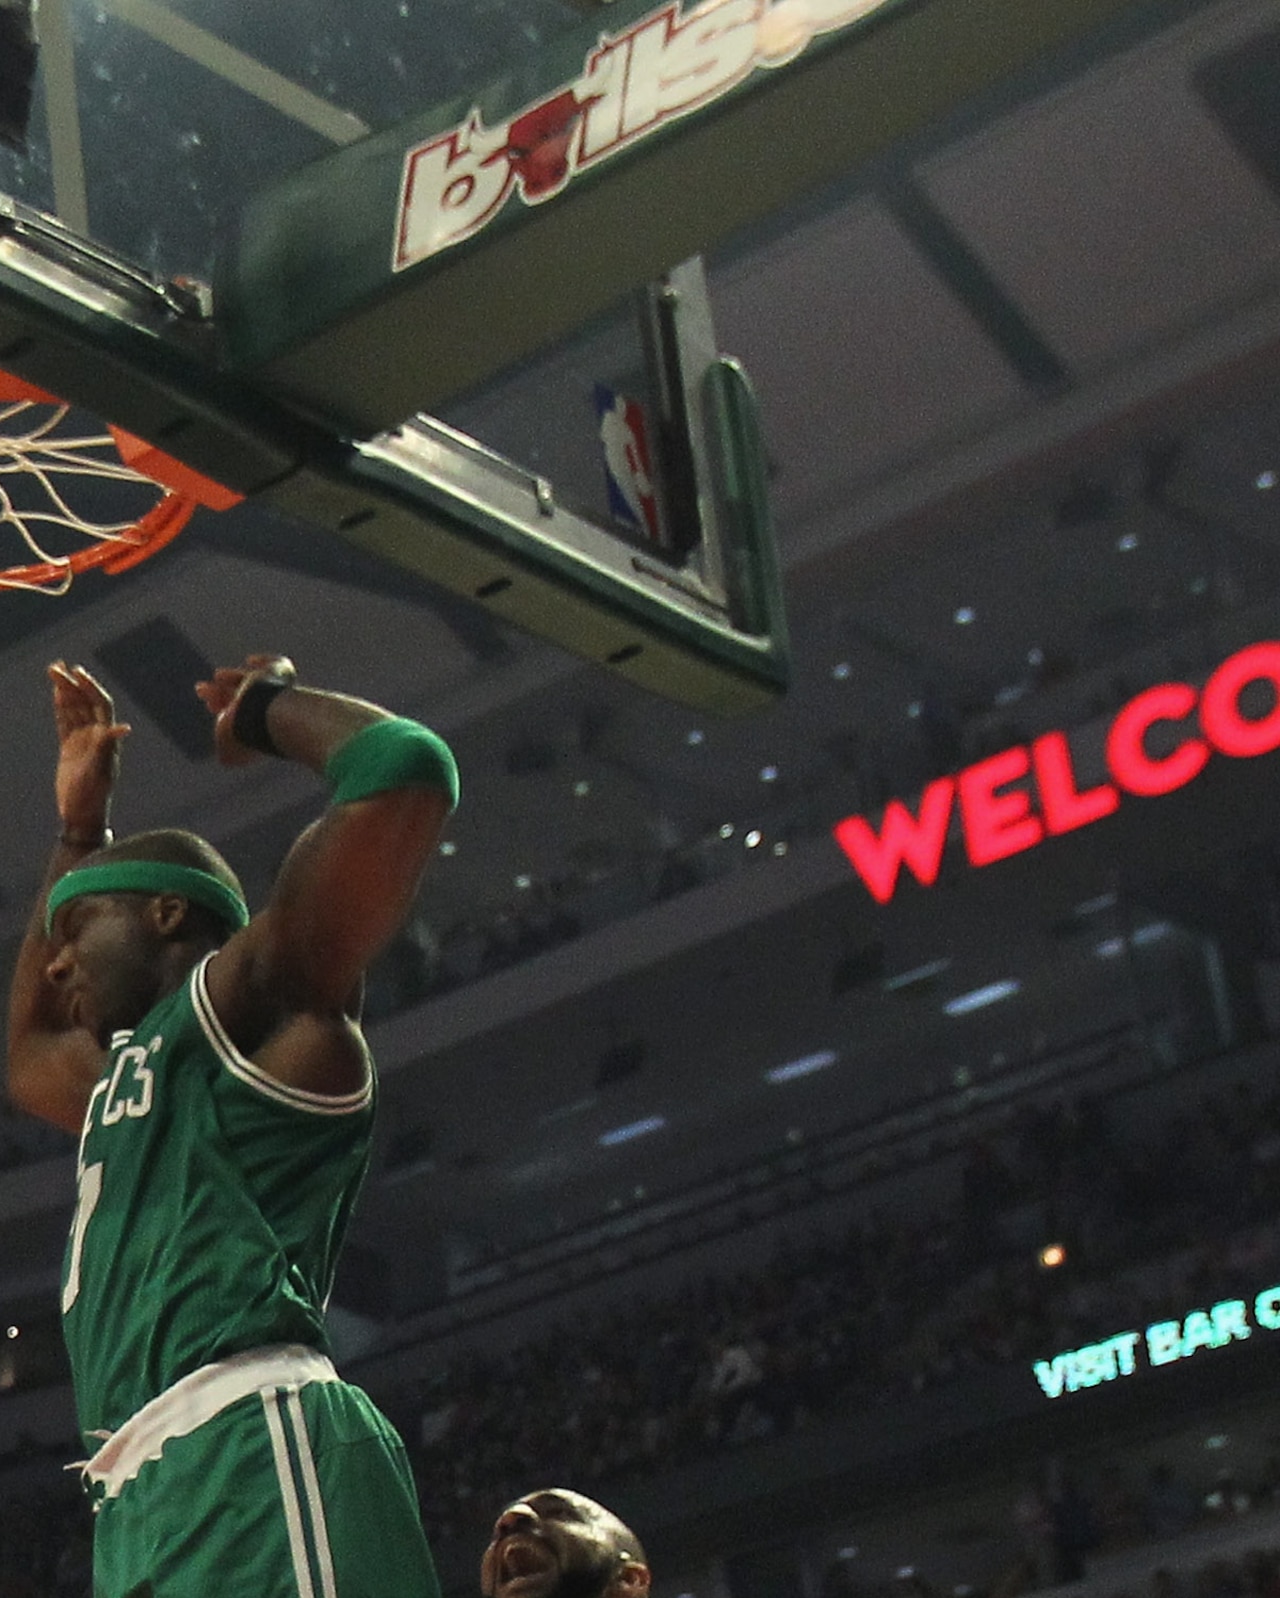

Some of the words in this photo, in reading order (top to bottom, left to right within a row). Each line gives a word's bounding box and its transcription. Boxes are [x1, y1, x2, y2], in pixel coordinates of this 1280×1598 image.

[832, 640, 1280, 905] WELCO
[1031, 1331, 1142, 1399] VISIT
[1144, 1299, 1253, 1368] BAR
